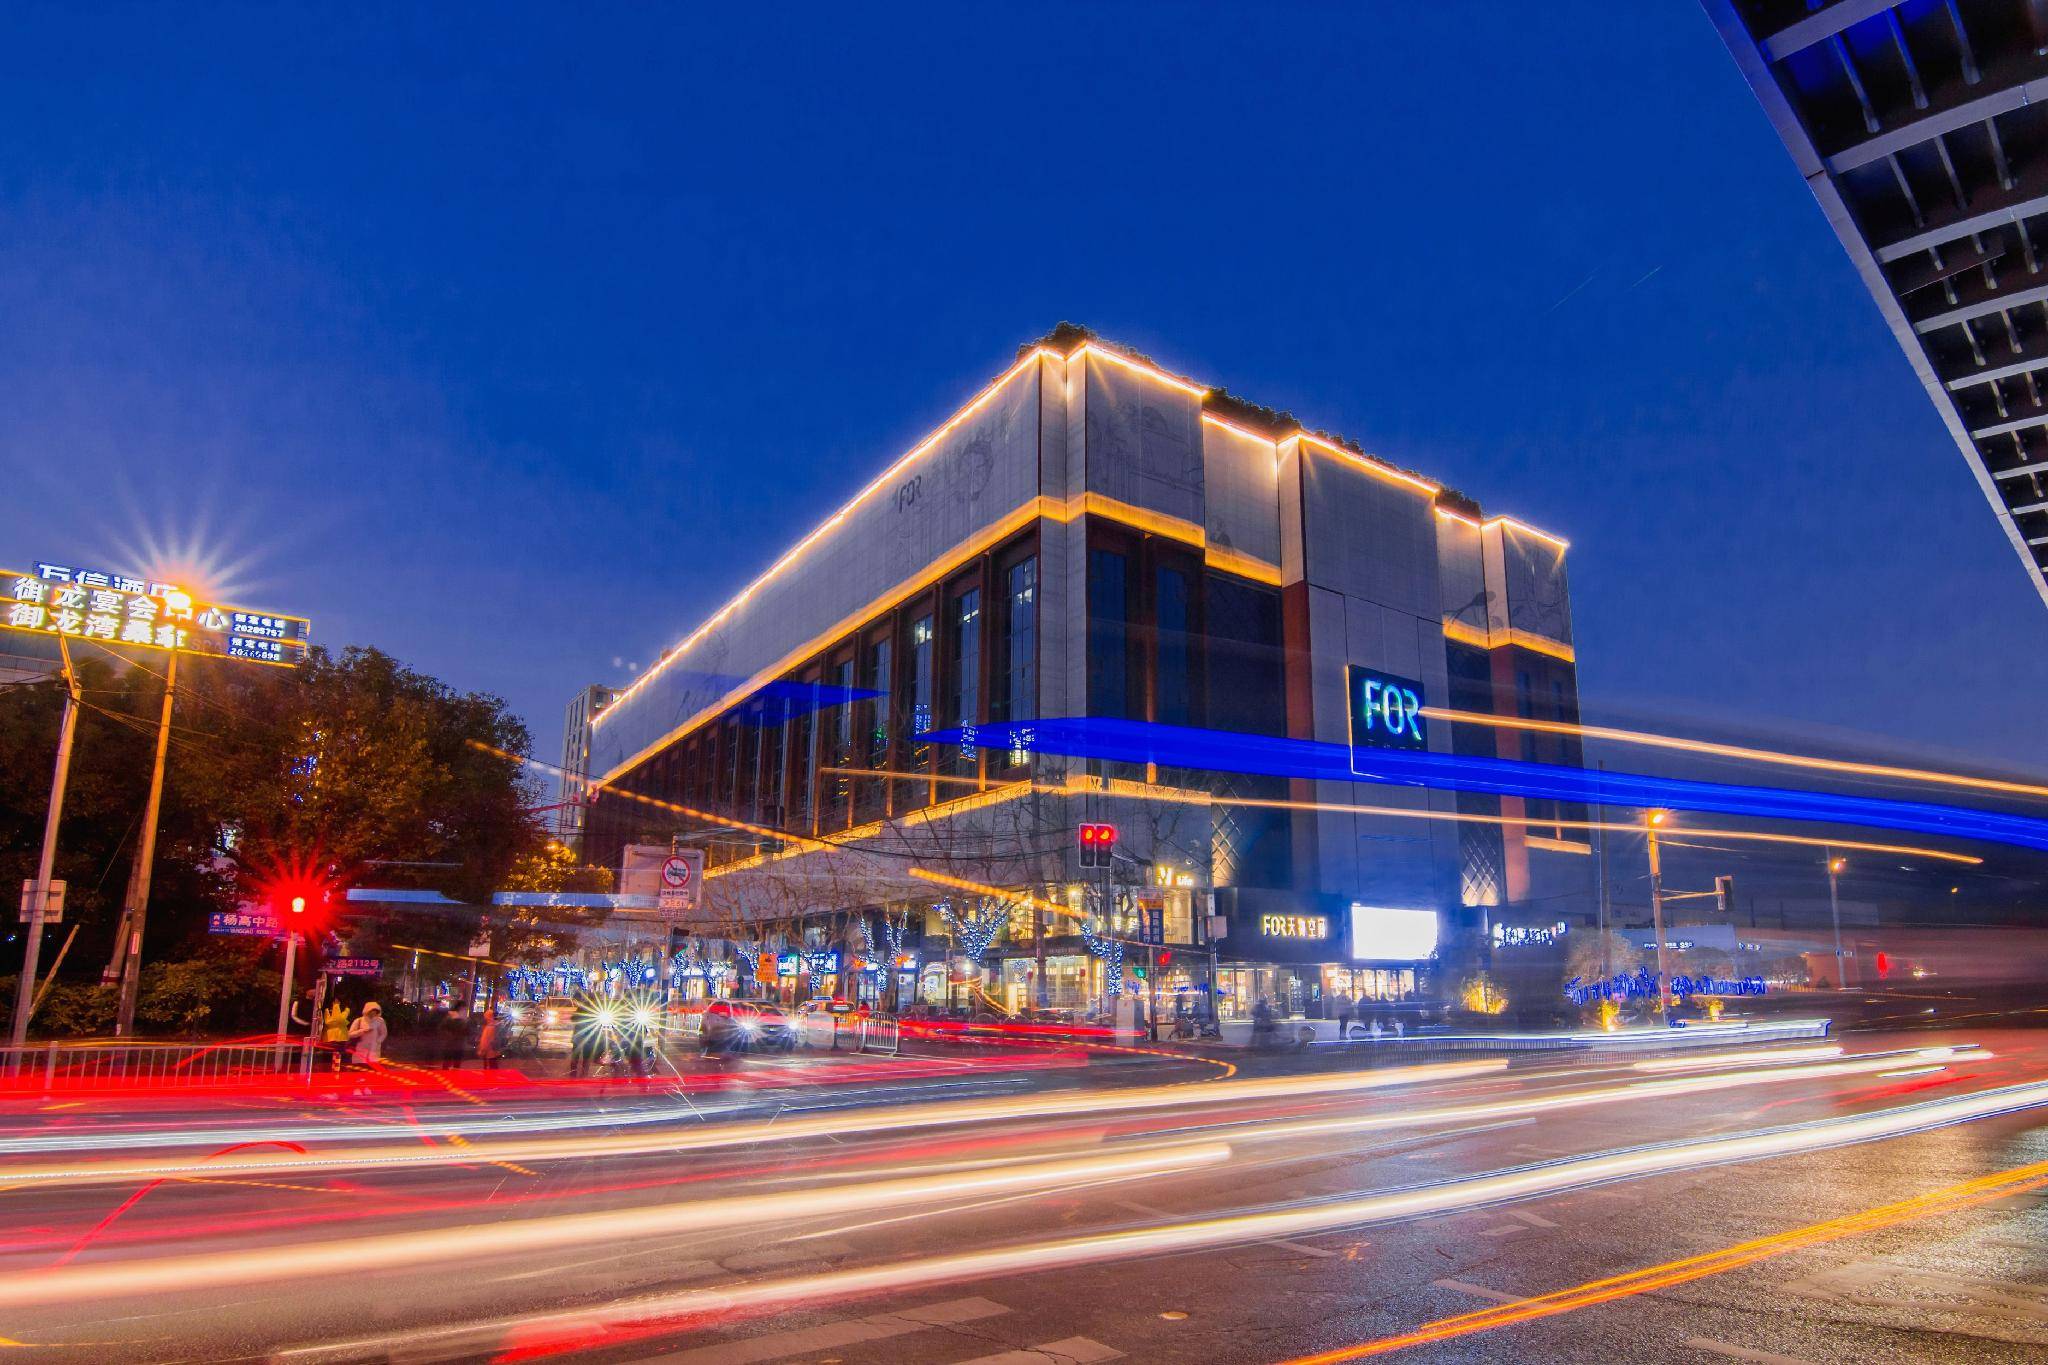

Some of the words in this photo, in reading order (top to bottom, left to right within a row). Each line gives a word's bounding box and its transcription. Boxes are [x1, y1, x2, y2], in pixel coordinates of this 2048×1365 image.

[1364, 680, 1422, 741] FOR
[223, 914, 279, 928] 杨高中路
